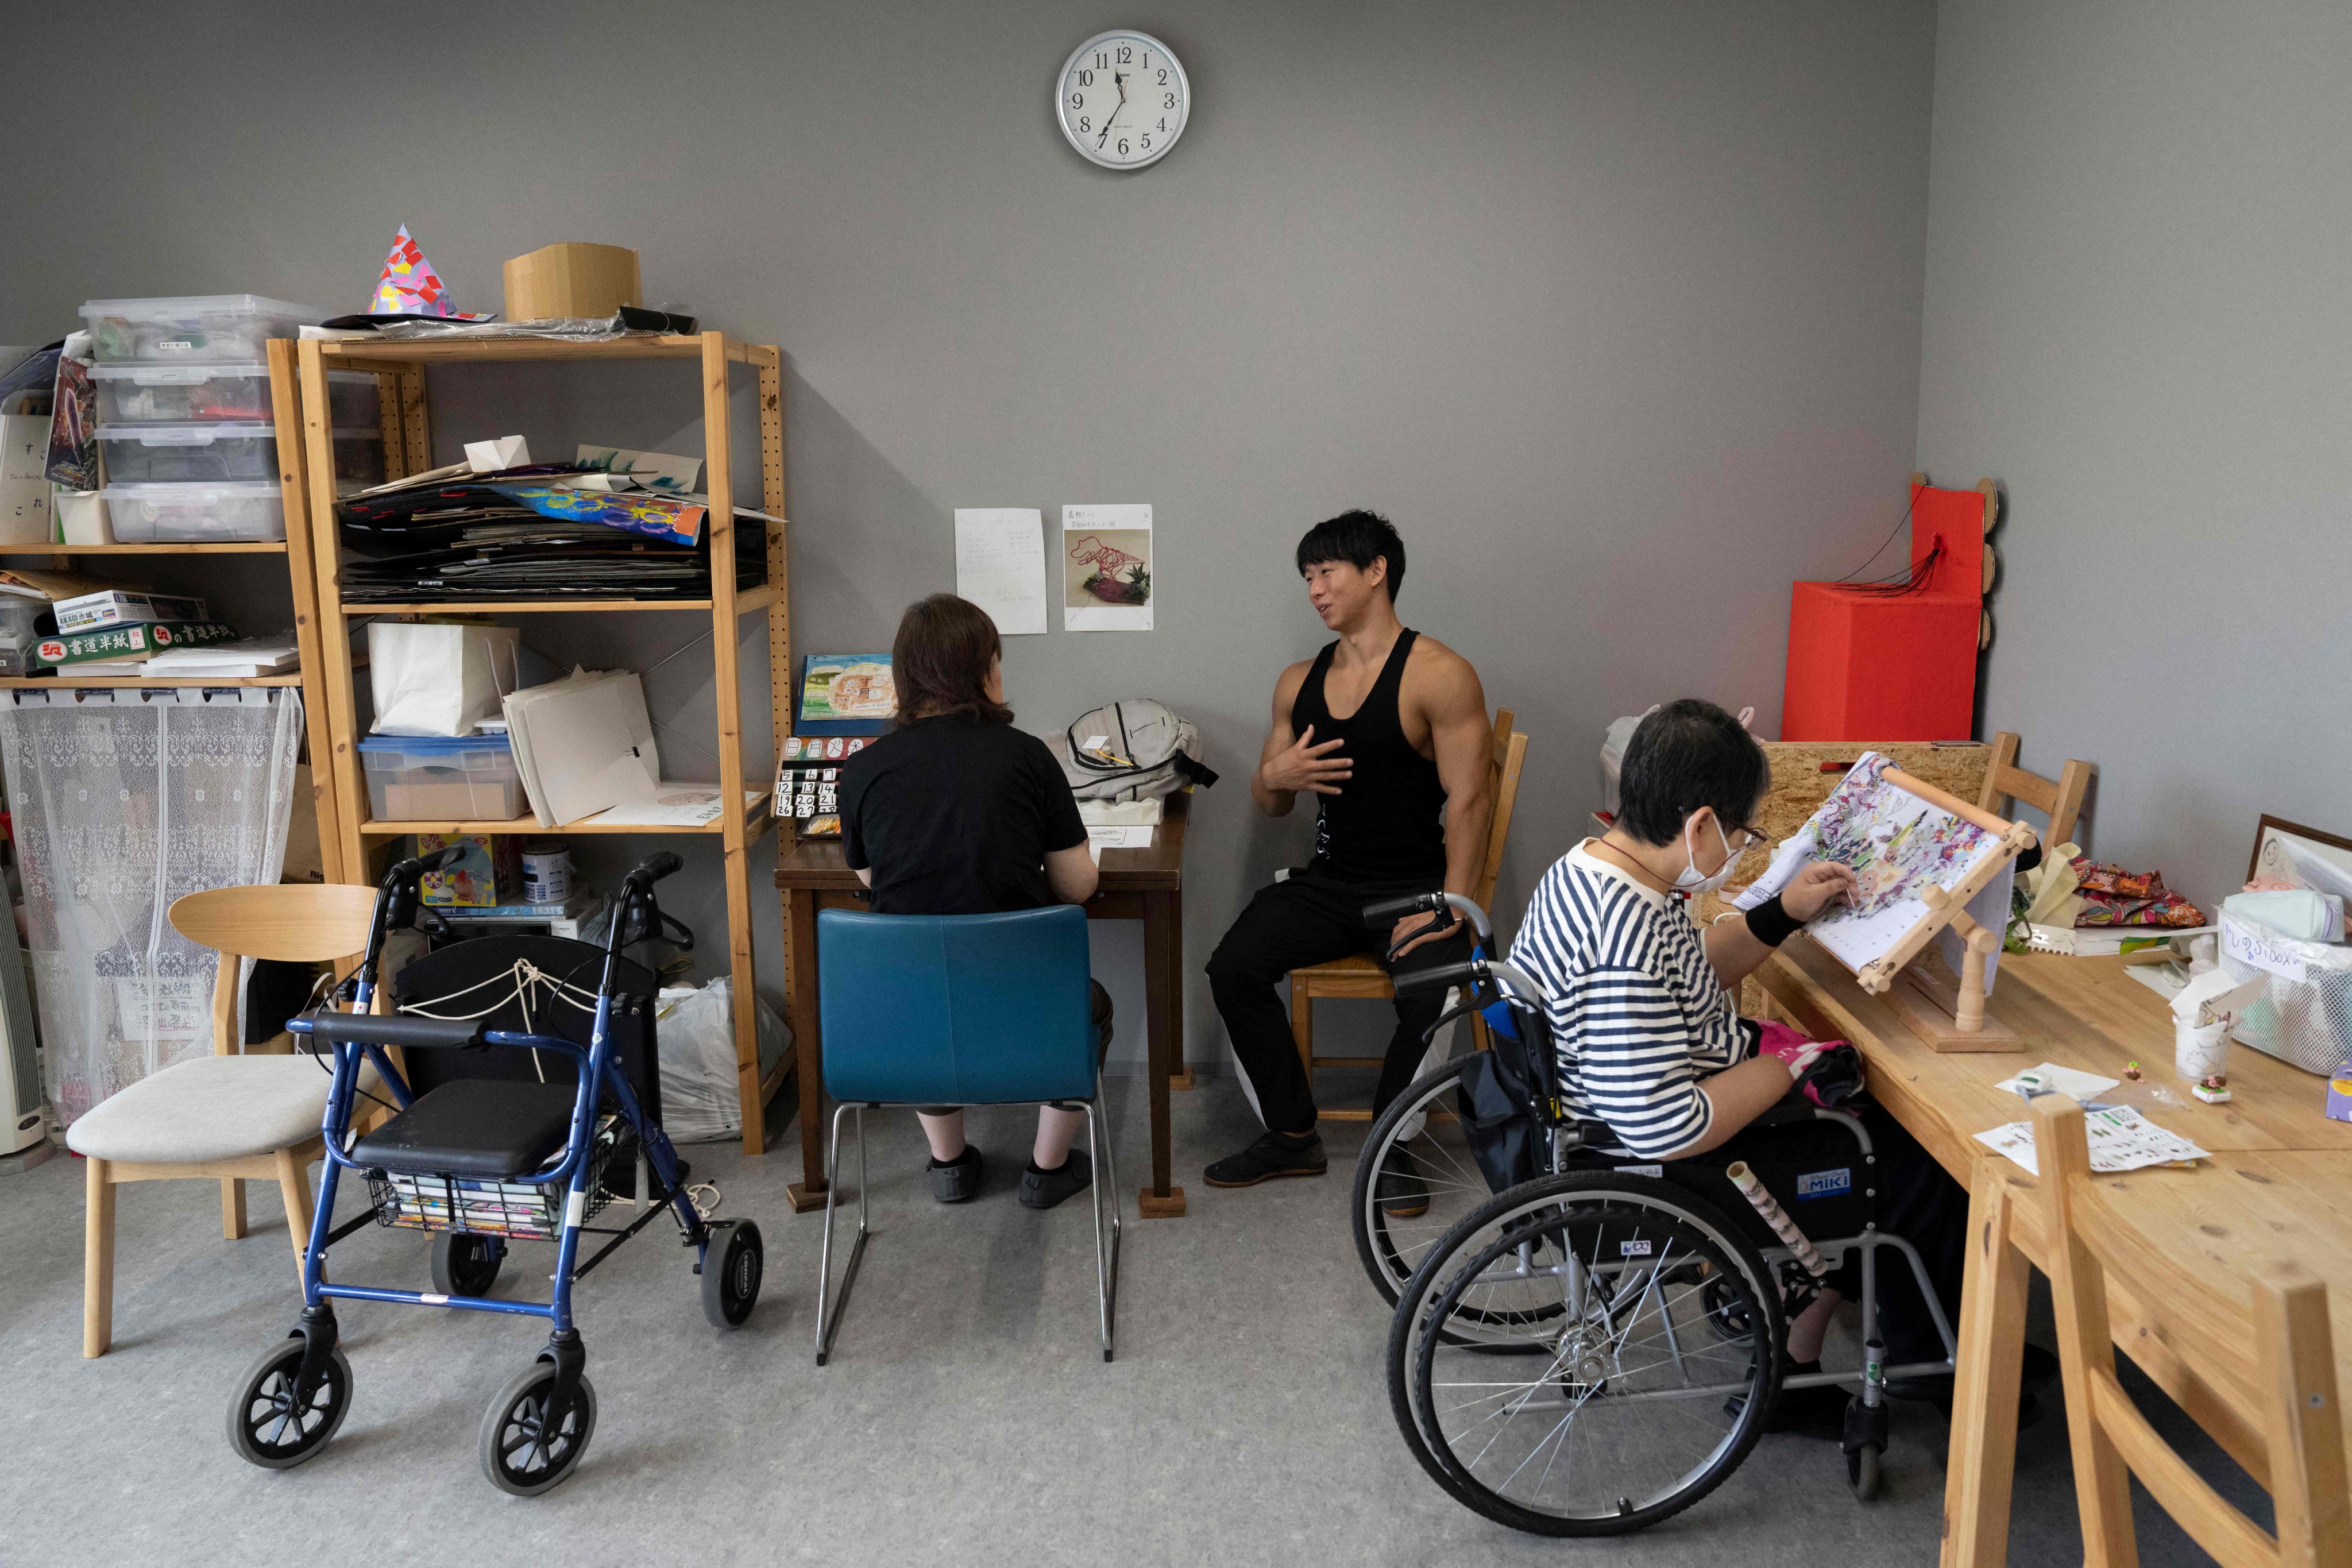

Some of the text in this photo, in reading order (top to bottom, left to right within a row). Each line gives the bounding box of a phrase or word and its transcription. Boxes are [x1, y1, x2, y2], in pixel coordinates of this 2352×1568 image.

[1095, 53, 1109, 69] 11
[1116, 47, 1131, 63] 12
[1143, 53, 1149, 68] 1
[1078, 69, 1094, 86] 10
[1157, 69, 1167, 86] 2
[1072, 93, 1083, 109] 9
[1164, 93, 1175, 109] 3
[1080, 117, 1091, 133] 8
[1156, 117, 1167, 132] 4
[1098, 133, 1108, 149] 7
[1118, 138, 1129, 155] 6
[1141, 133, 1150, 148] 5
[59, 614, 78, 625] AKAGI
[78, 611, 93, 620] 赤城
[68, 633, 129, 655] 書道半紙
[786, 740, 800, 754] 日
[808, 740, 821, 756] 月
[828, 740, 842, 756] 火
[783, 769, 833, 779] 5 6 7
[778, 783, 833, 793] 12 13 14
[780, 795, 834, 805] 19 20 21
[778, 806, 790, 814] 26
[798, 806, 813, 815] 27
